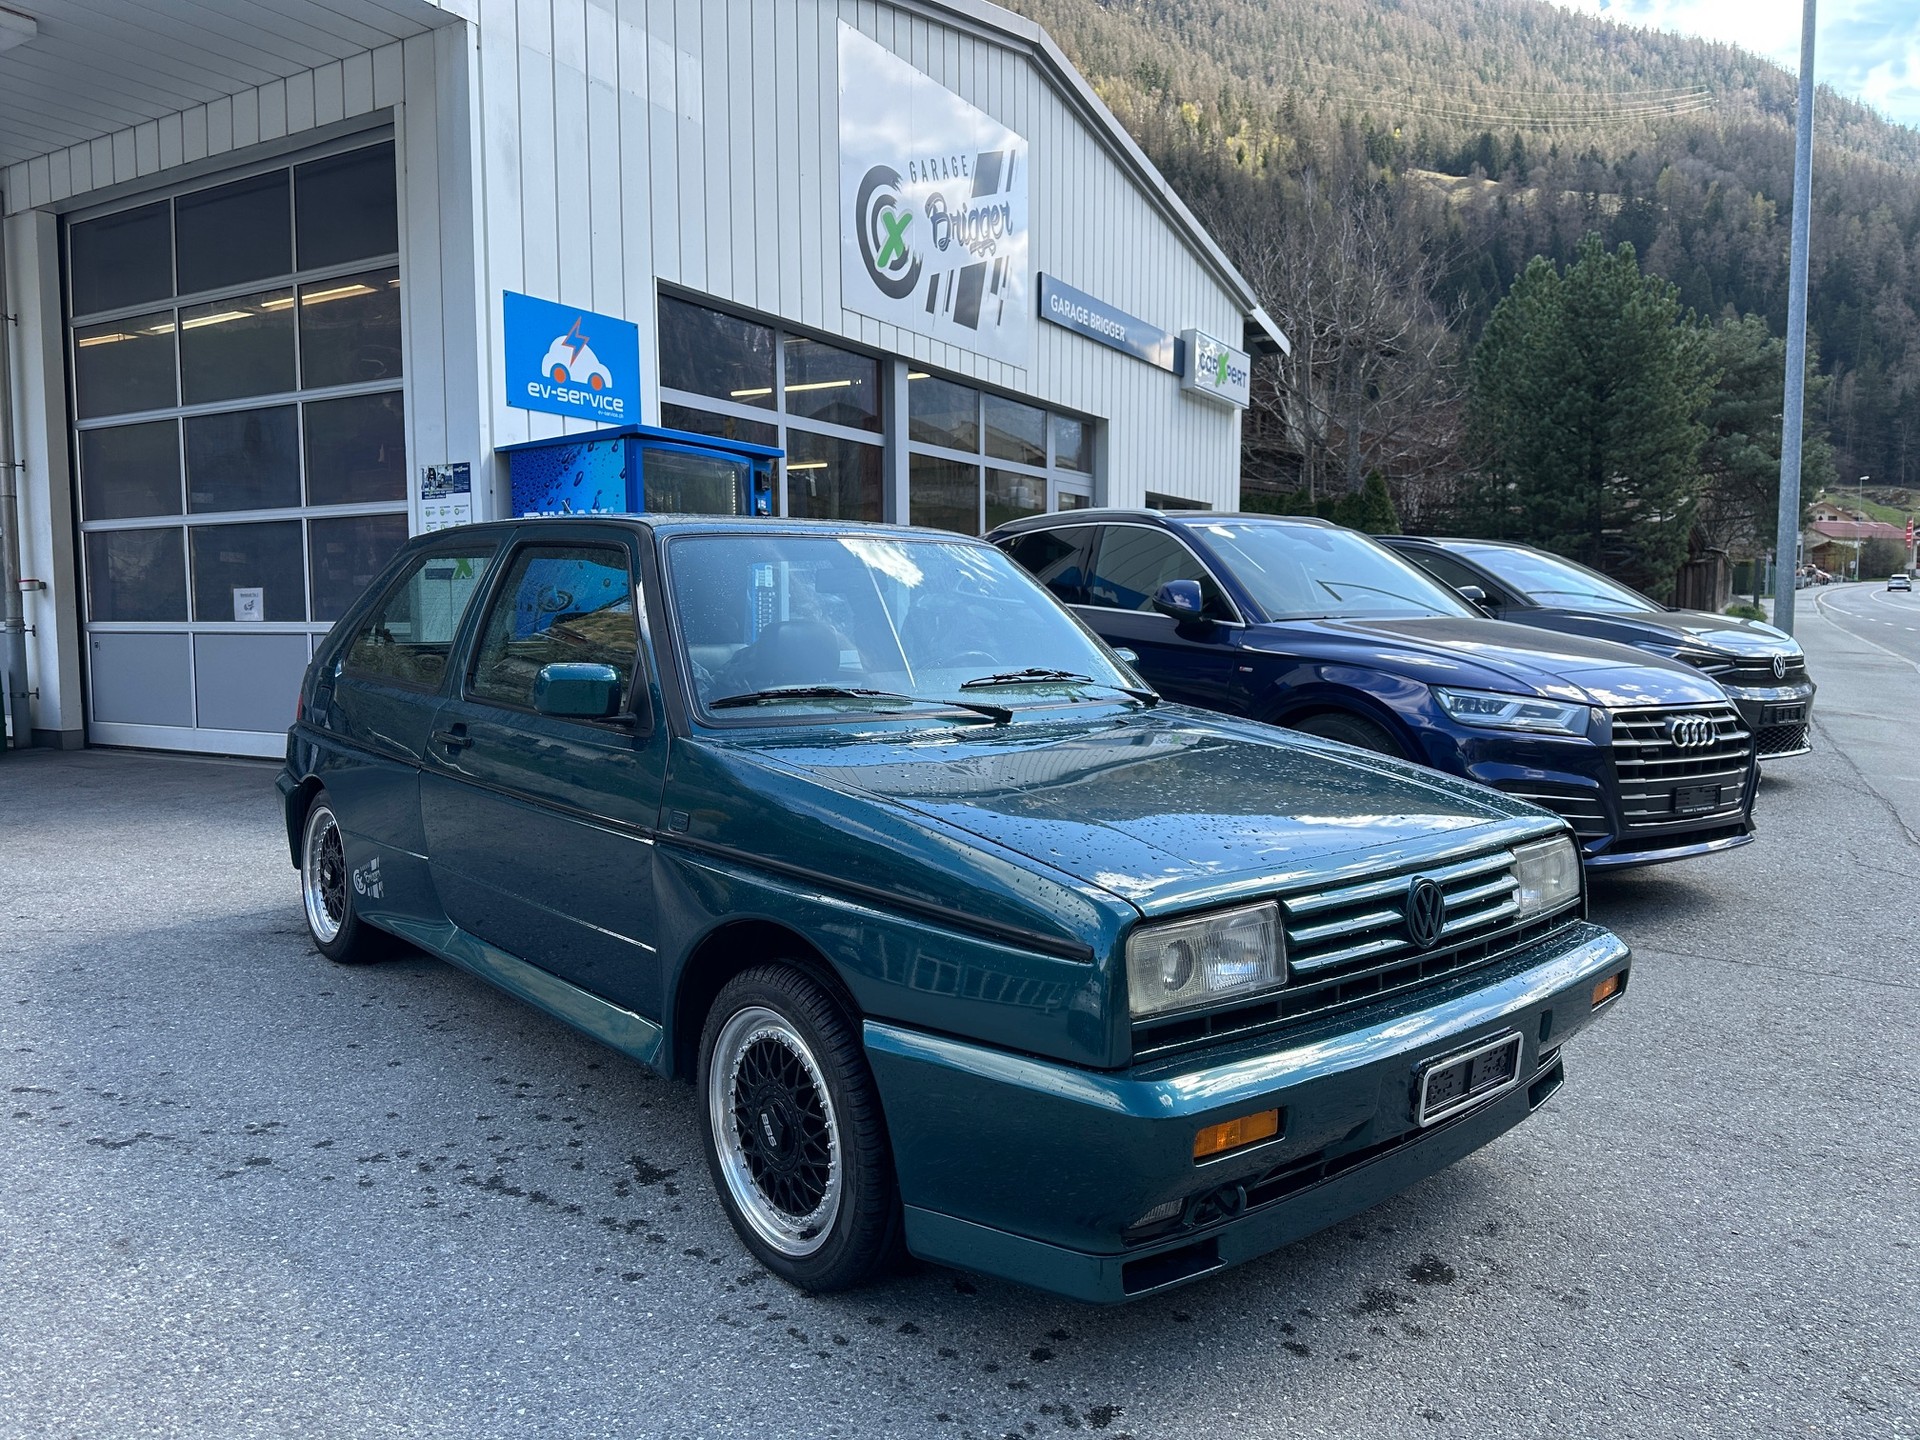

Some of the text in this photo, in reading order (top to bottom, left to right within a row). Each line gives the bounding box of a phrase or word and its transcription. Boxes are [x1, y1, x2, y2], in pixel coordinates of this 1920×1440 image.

[909, 154, 969, 184] GARAGE
[925, 192, 1013, 258] Brigger
[1050, 294, 1125, 342] GARAGE BRIGGER
[527, 381, 624, 412] ev-service
[761, 1113, 777, 1147] BBS
